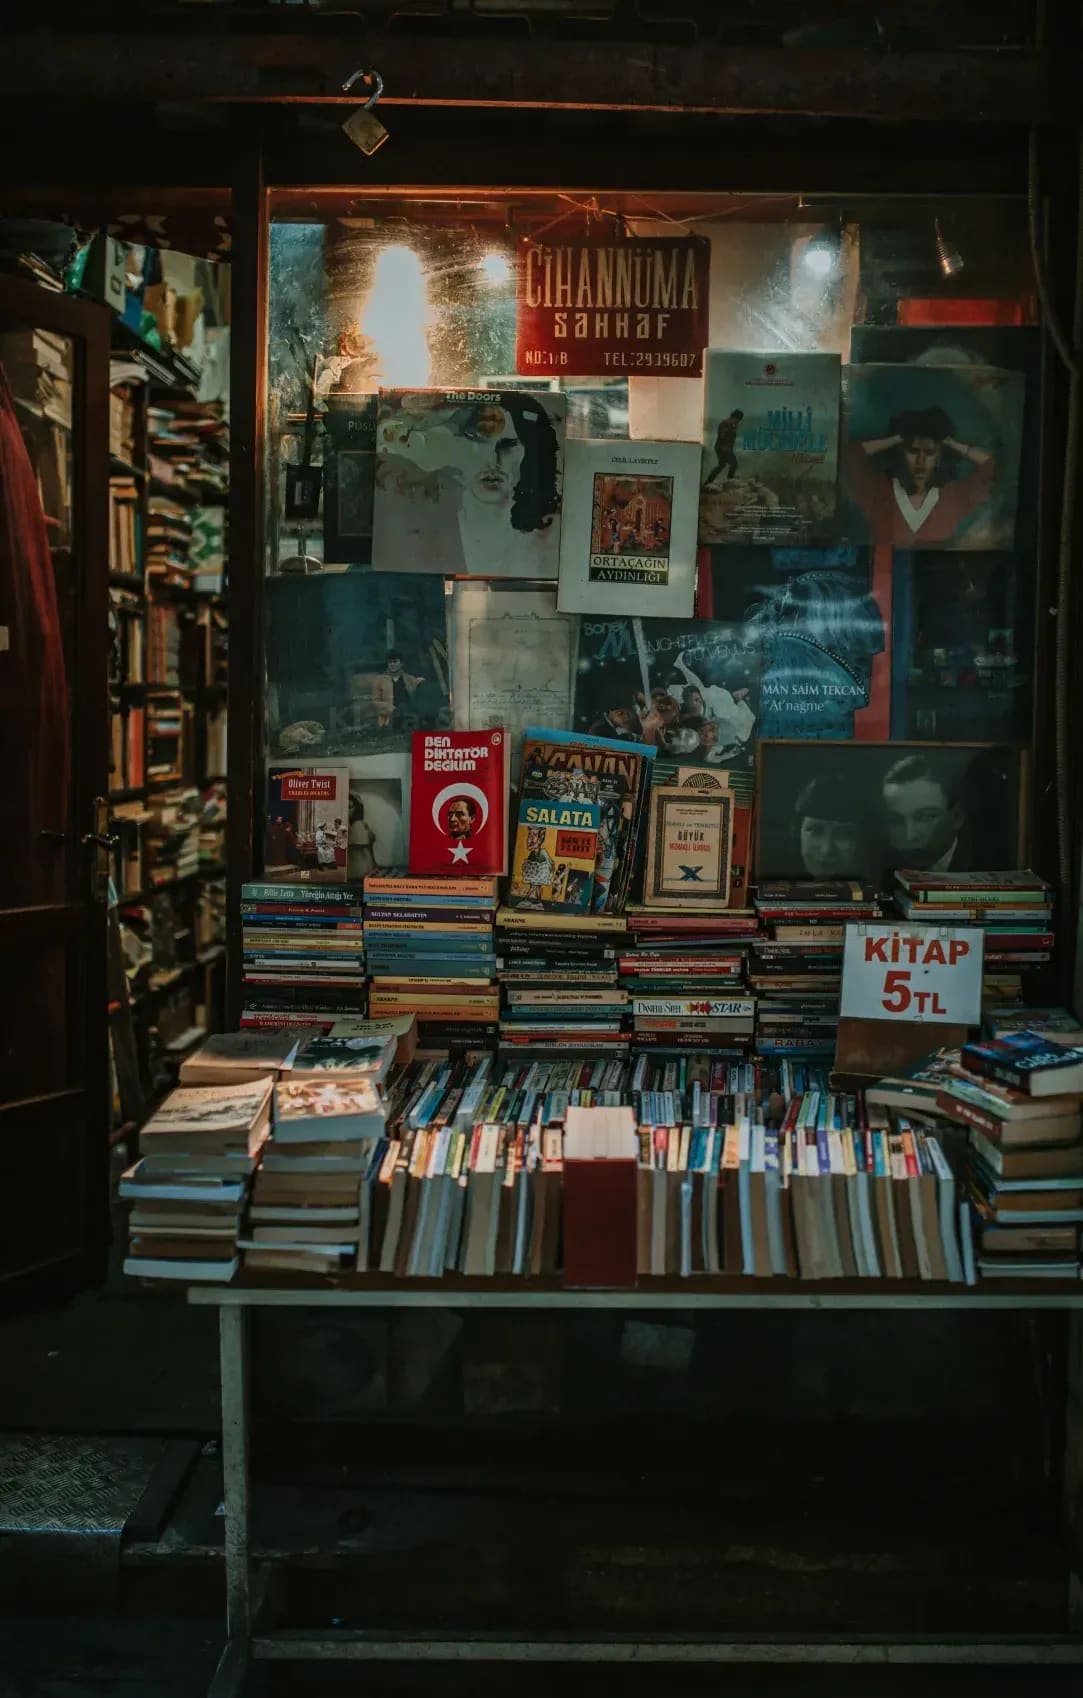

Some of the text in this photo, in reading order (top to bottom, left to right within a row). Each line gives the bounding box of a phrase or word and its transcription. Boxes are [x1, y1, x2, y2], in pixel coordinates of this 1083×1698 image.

[526, 247, 699, 309] CİHANNÜMA
[447, 390, 501, 402] The Doors
[593, 556, 667, 570] ORTAÇAĞIN
[597, 570, 661, 583] AYDINLIĞI
[791, 681, 819, 696] SAİM
[822, 684, 866, 697] TEKCAN
[424, 736, 451, 748] BEN
[288, 779, 330, 789] Oliver Twist
[526, 806, 593, 828] SALATA
[677, 829, 705, 841] BÜYÜK
[343, 891, 355, 901] Yer
[865, 932, 970, 965] KİTAP
[712, 1003, 742, 1013] STAR
